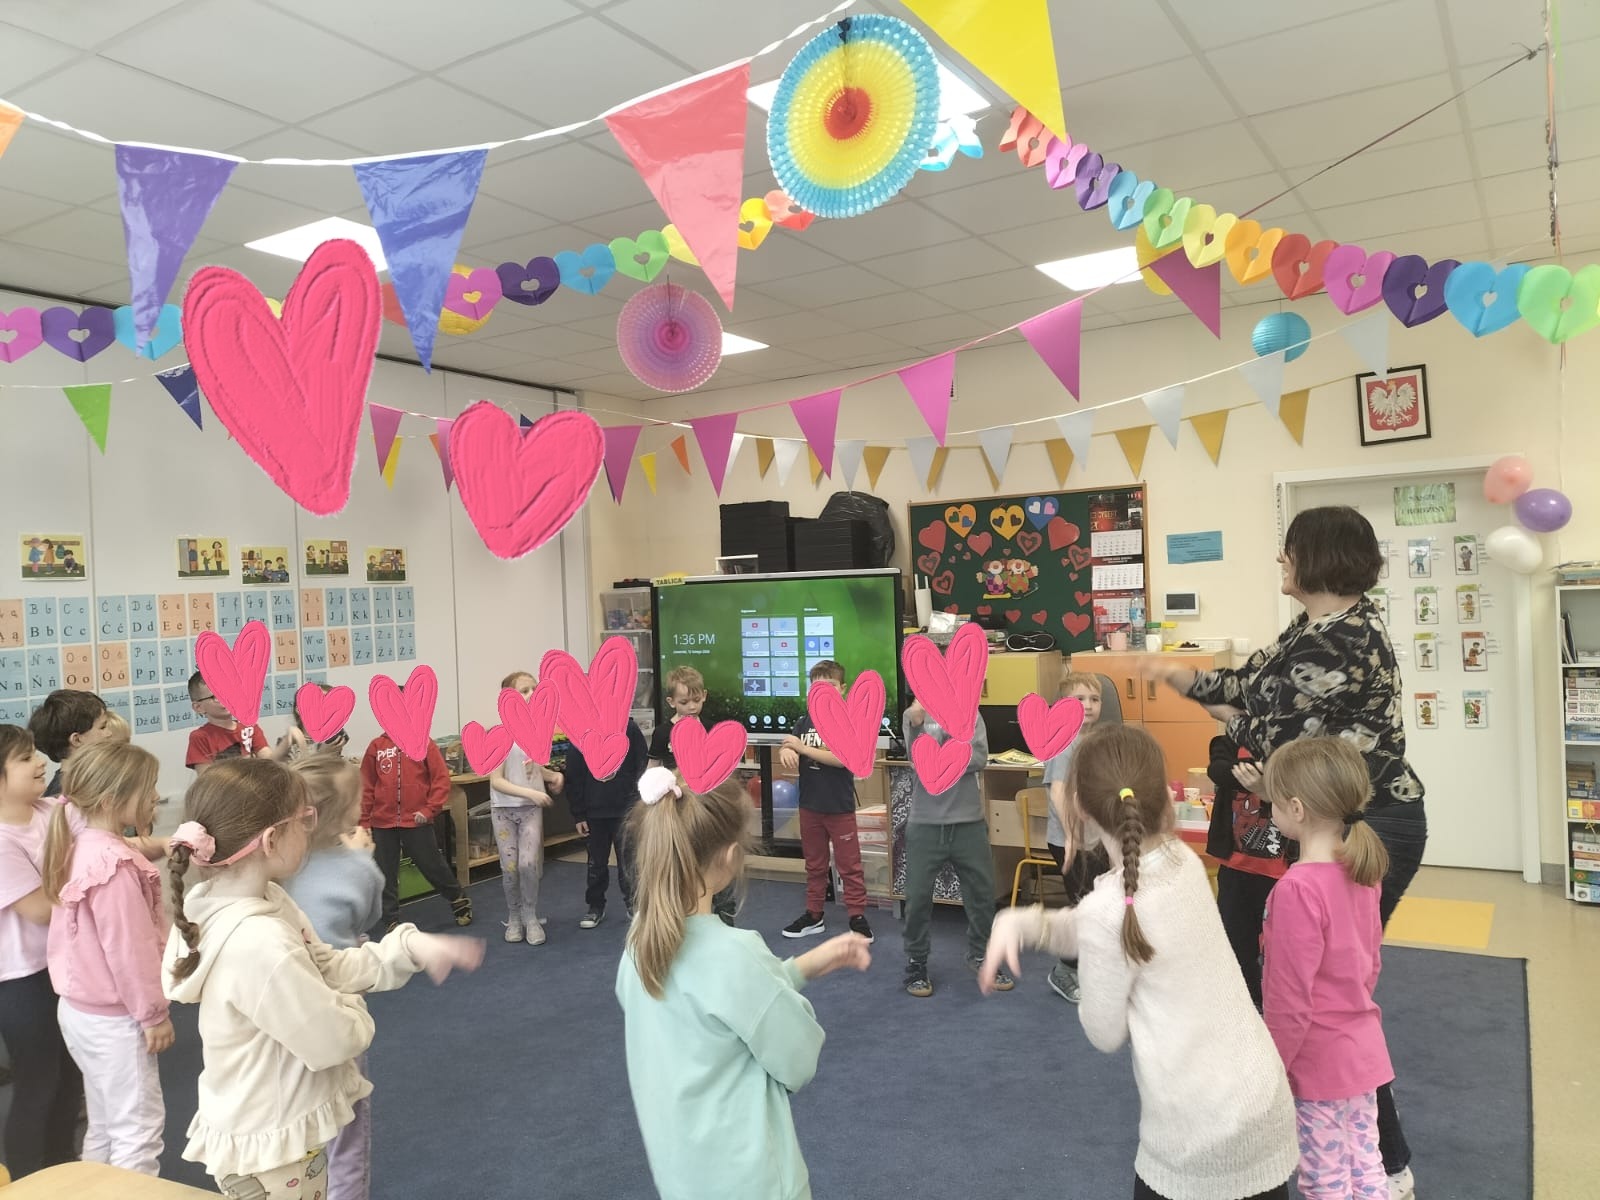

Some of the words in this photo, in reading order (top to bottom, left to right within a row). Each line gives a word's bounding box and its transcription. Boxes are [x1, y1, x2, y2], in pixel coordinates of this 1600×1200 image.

[30, 603, 39, 615] B
[63, 603, 71, 614] C
[275, 614, 282, 624] H
[286, 614, 292, 623] h
[352, 610, 359, 620] K
[363, 609, 368, 619] k
[132, 622, 142, 632] D
[147, 621, 154, 631] d
[163, 620, 170, 631] E
[176, 622, 183, 630] e
[221, 617, 228, 627] F
[235, 616, 240, 627] f
[30, 626, 40, 638] B
[46, 625, 54, 637] b
[63, 626, 72, 637] C
[79, 628, 86, 636] c
[102, 621, 111, 635] Ć
[117, 623, 124, 634] ć
[673, 633, 695, 645] 1:36
[698, 633, 715, 645] PM
[66, 652, 74, 663] O
[277, 656, 286, 665] U
[305, 654, 315, 663] W
[331, 653, 338, 662] Y
[342, 654, 347, 663] y
[102, 669, 112, 682] Ó
[118, 670, 125, 680] ó
[136, 668, 143, 679] P
[149, 669, 156, 680] p
[165, 667, 174, 677] R
[179, 668, 185, 676] r
[32, 675, 42, 689] Ń
[66, 674, 77, 685] O
[82, 676, 90, 684] o
[15, 682, 23, 690] n
